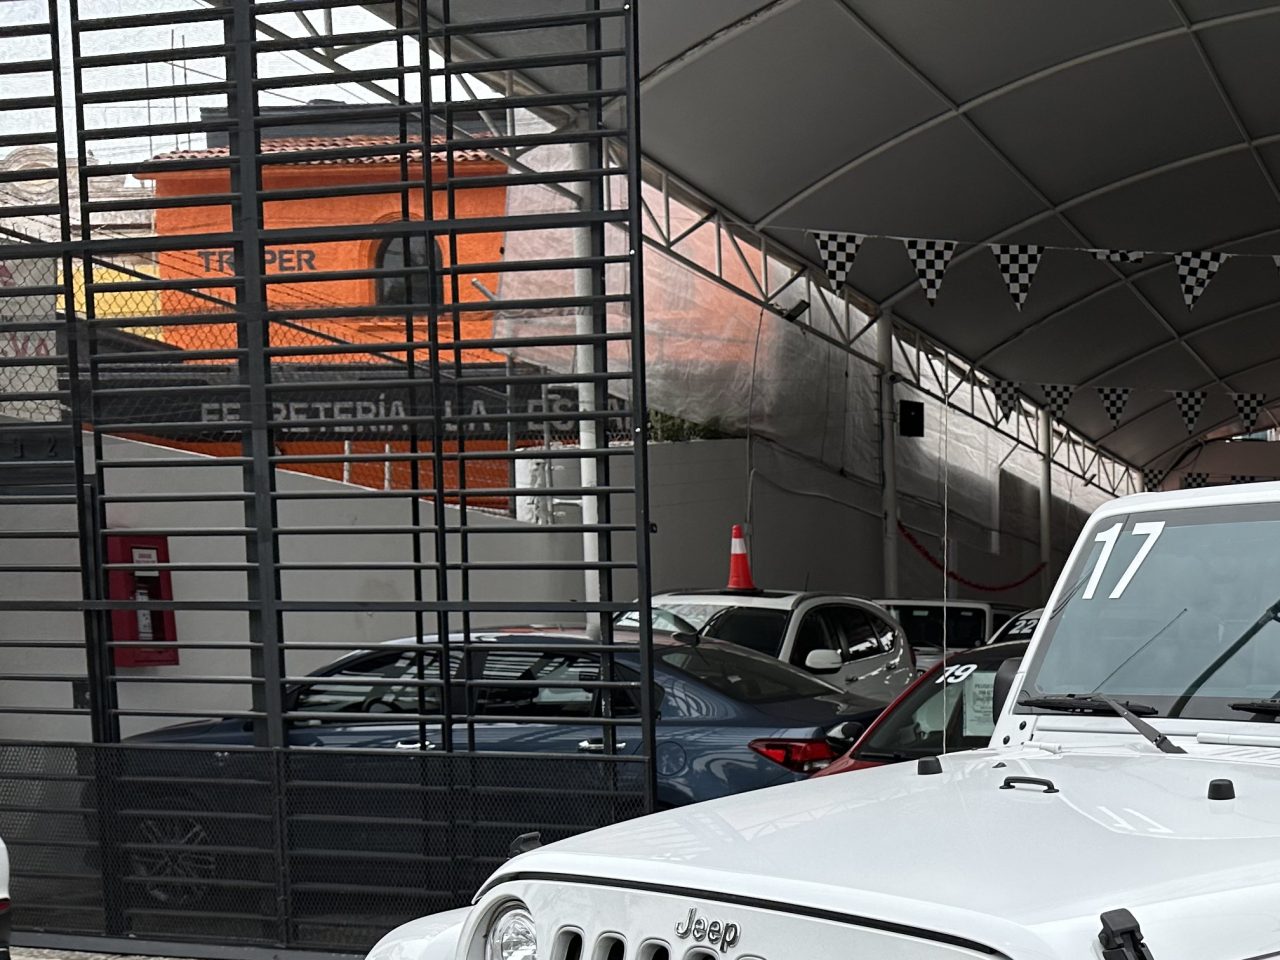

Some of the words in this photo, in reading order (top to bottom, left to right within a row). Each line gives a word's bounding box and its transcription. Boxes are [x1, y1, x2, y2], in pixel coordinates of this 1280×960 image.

[197, 249, 317, 273] TRPER
[201, 392, 409, 433] FERETERÍA
[445, 399, 492, 432] LA
[1081, 520, 1166, 600] 17
[1007, 619, 1040, 635] 22
[934, 663, 978, 684] 19
[674, 906, 741, 954] Jeep
